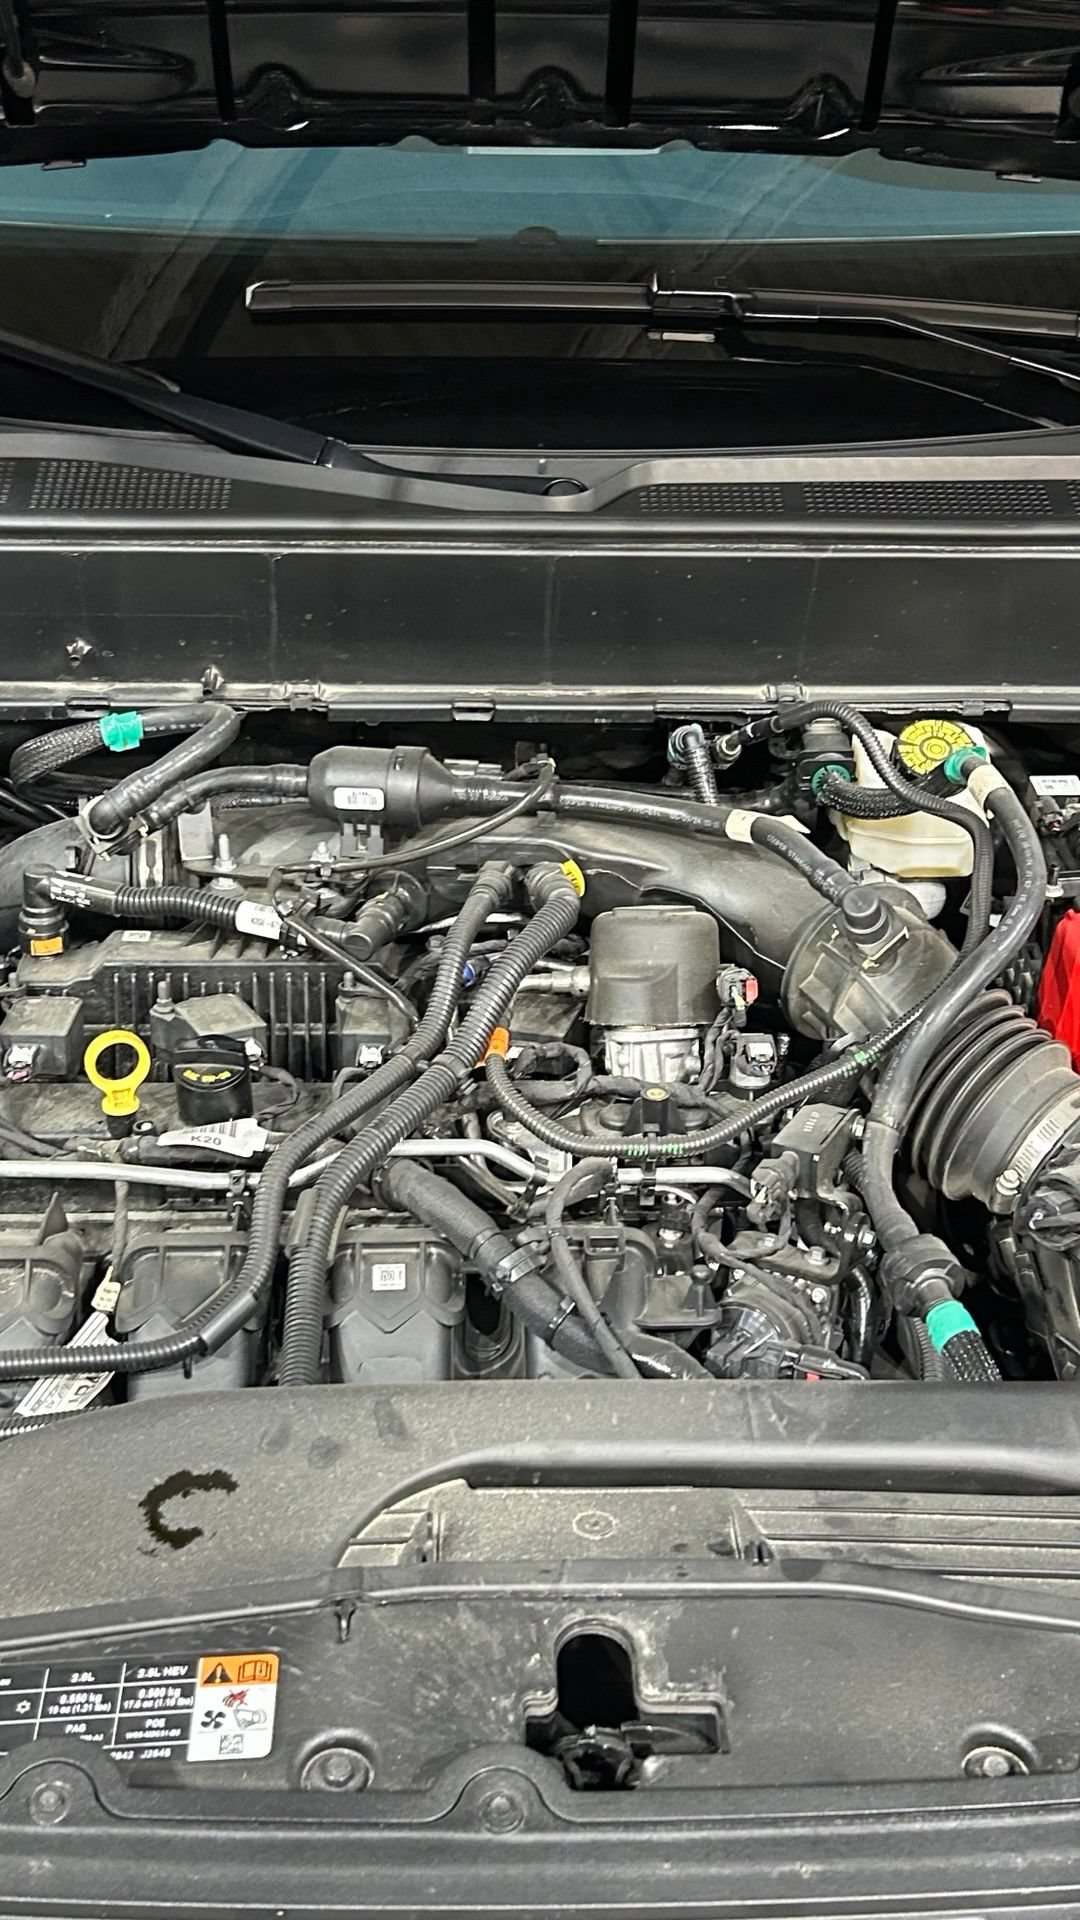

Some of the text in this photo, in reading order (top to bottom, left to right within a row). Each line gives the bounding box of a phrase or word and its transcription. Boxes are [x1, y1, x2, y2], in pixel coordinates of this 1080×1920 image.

[190, 1135, 222, 1146] K20
[163, 1665, 189, 1677] HEV
[167, 1686, 181, 1698] kg
